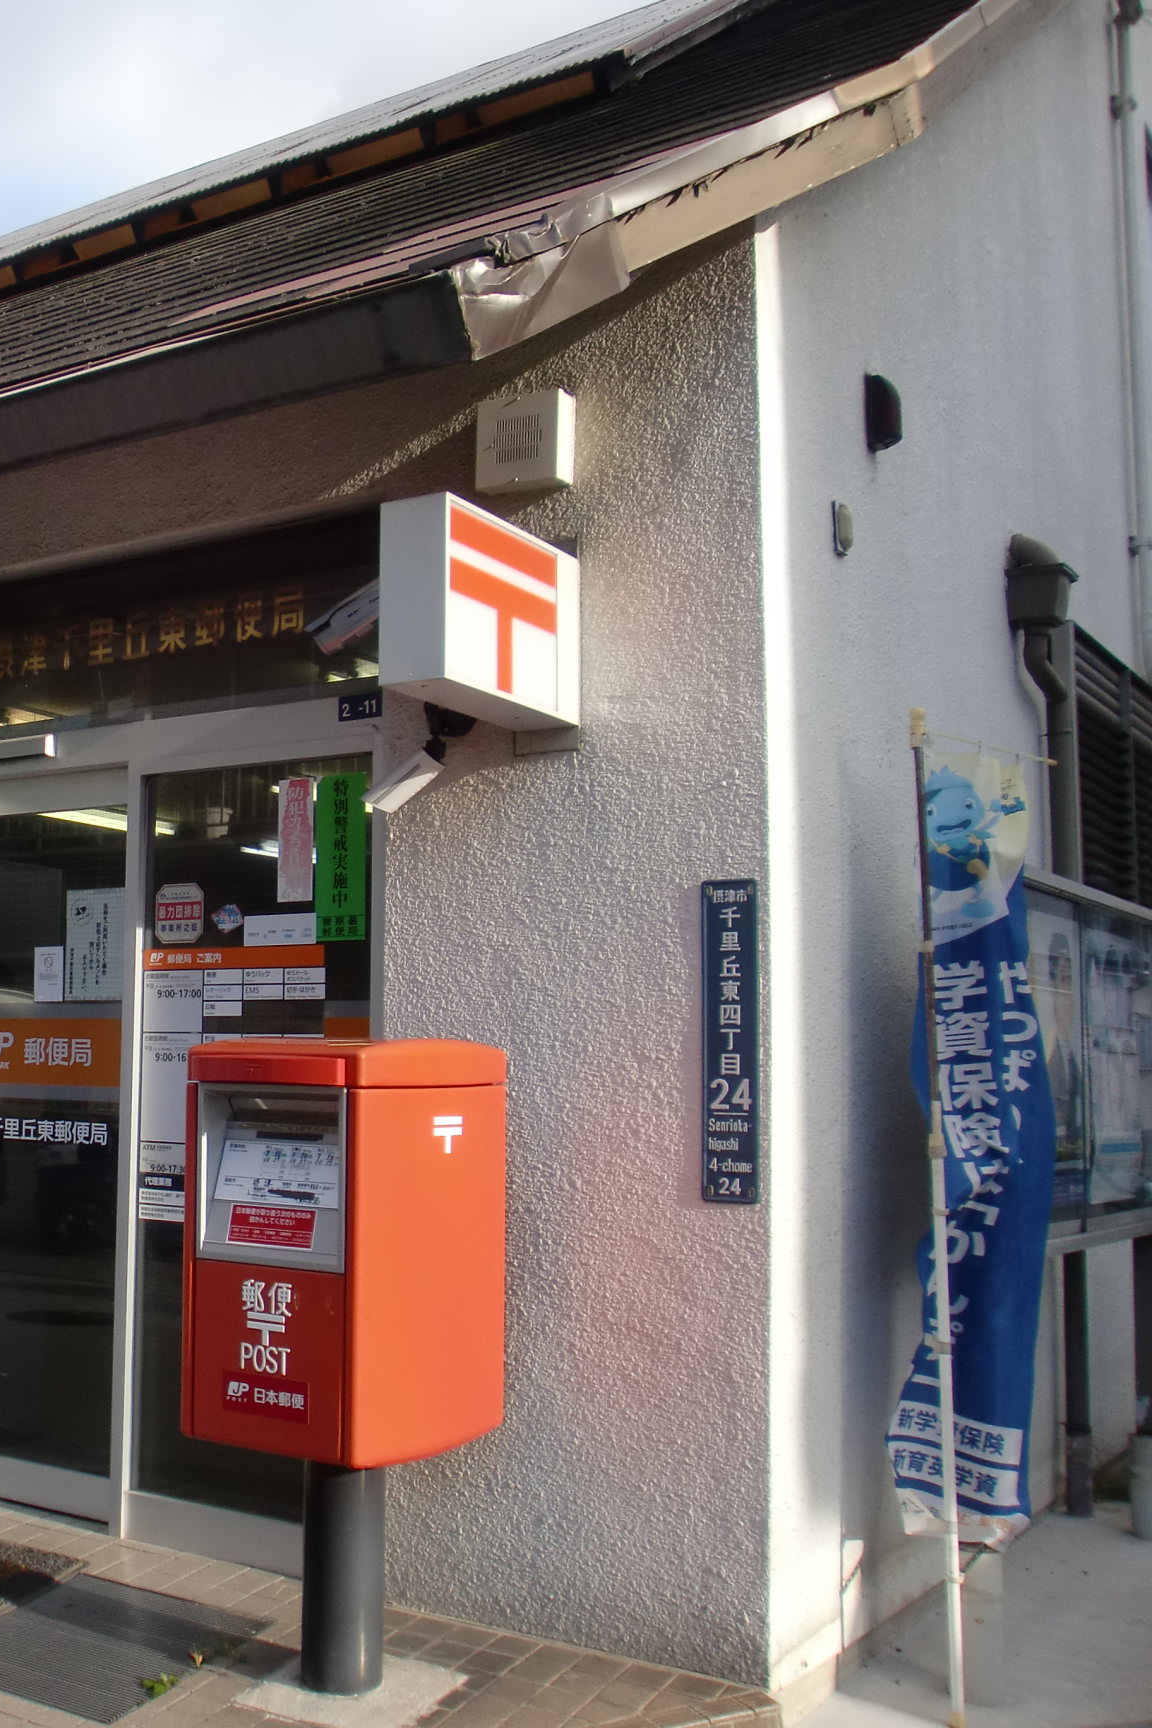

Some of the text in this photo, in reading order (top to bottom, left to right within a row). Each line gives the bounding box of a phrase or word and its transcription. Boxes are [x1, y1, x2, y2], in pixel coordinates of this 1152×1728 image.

[332, 779, 349, 910] 特別警戒実施中
[713, 889, 748, 904] 摂津市
[159, 904, 200, 919] 暴力団排除
[167, 953, 192, 964] 郵便局
[196, 952, 222, 963] ご案内
[157, 988, 202, 999] 9:00-17:00
[719, 906, 742, 1077] 千里丘東四丁目
[23, 1037, 92, 1067] 郵便局
[155, 1052, 187, 1062] 9:00-16
[709, 1078, 752, 1111] 24
[708, 1118, 752, 1133] Senrioka-
[709, 1137, 739, 1153] higashi
[709, 1158, 753, 1173] 4-chome
[719, 1178, 742, 1195] 24
[241, 1278, 293, 1318] 郵便
[240, 1342, 291, 1376] POST
[227, 1380, 305, 1411] JP 日本郵便
[898, 1407, 1005, 1456] 新学保険
